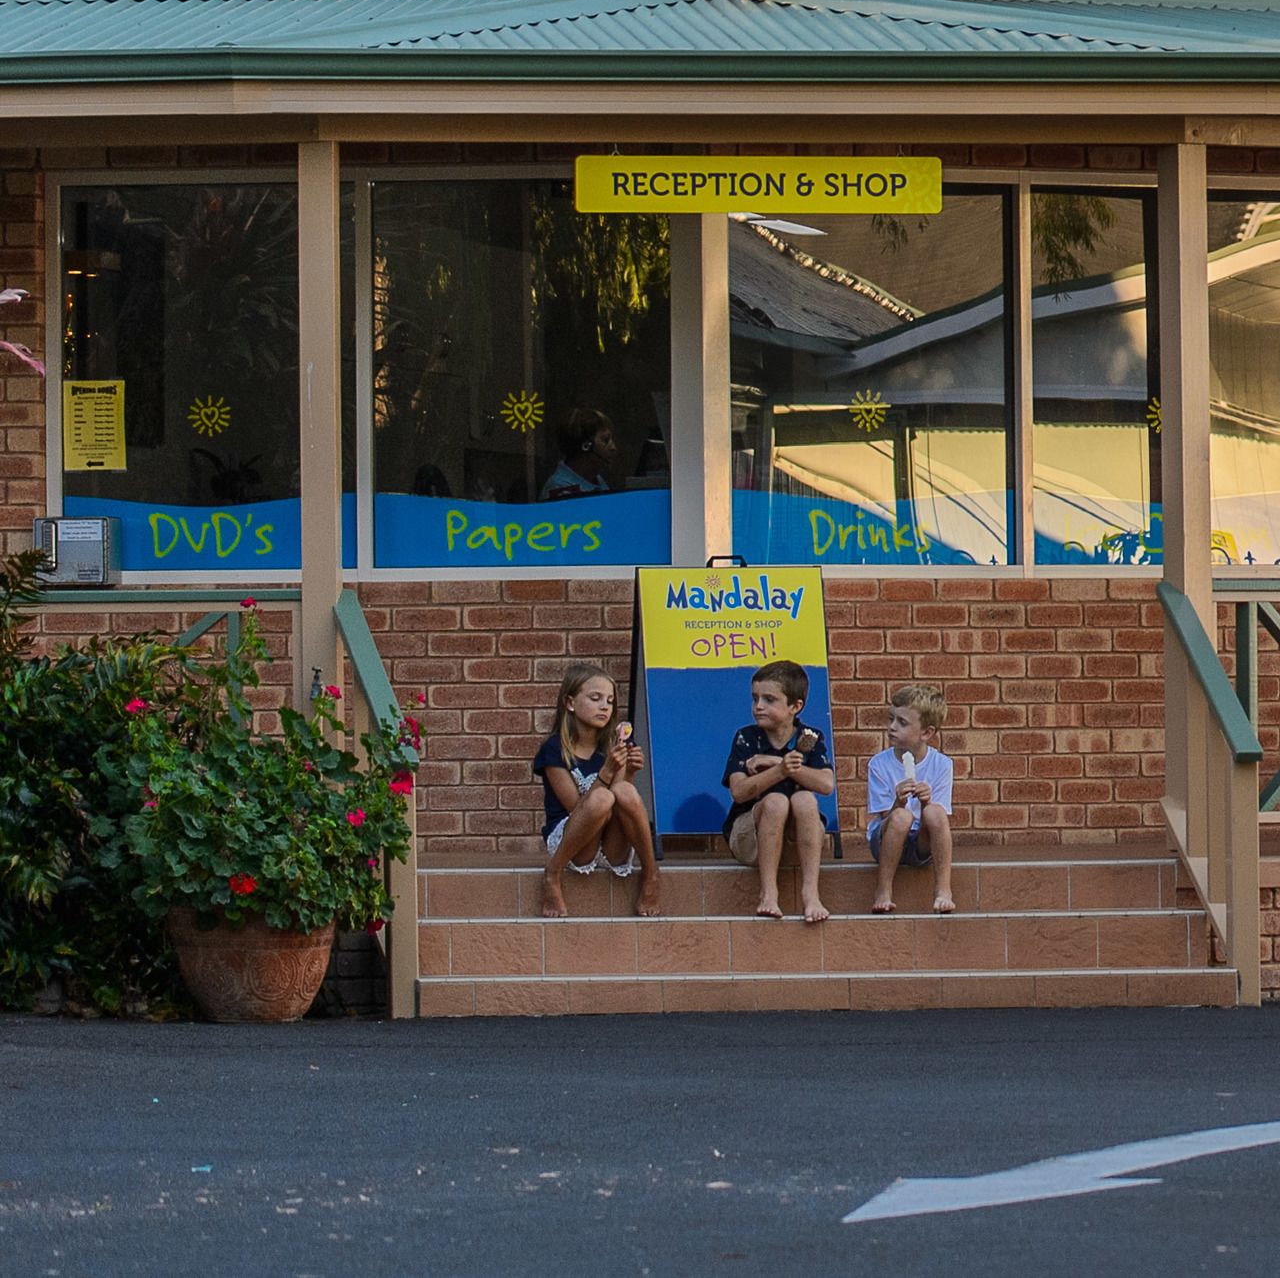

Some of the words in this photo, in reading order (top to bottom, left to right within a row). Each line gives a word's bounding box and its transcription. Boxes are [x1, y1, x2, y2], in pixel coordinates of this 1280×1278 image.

[611, 171, 787, 197] RECEPTION
[795, 174, 815, 196] &
[824, 172, 908, 197] SHOP
[148, 511, 274, 559] DVD's
[446, 509, 602, 561] Papers
[808, 508, 932, 556] Drinks
[684, 620, 742, 630] RECEPTION
[745, 621, 752, 629] &
[754, 620, 783, 629] SHOP
[690, 632, 777, 660] OPEN!
